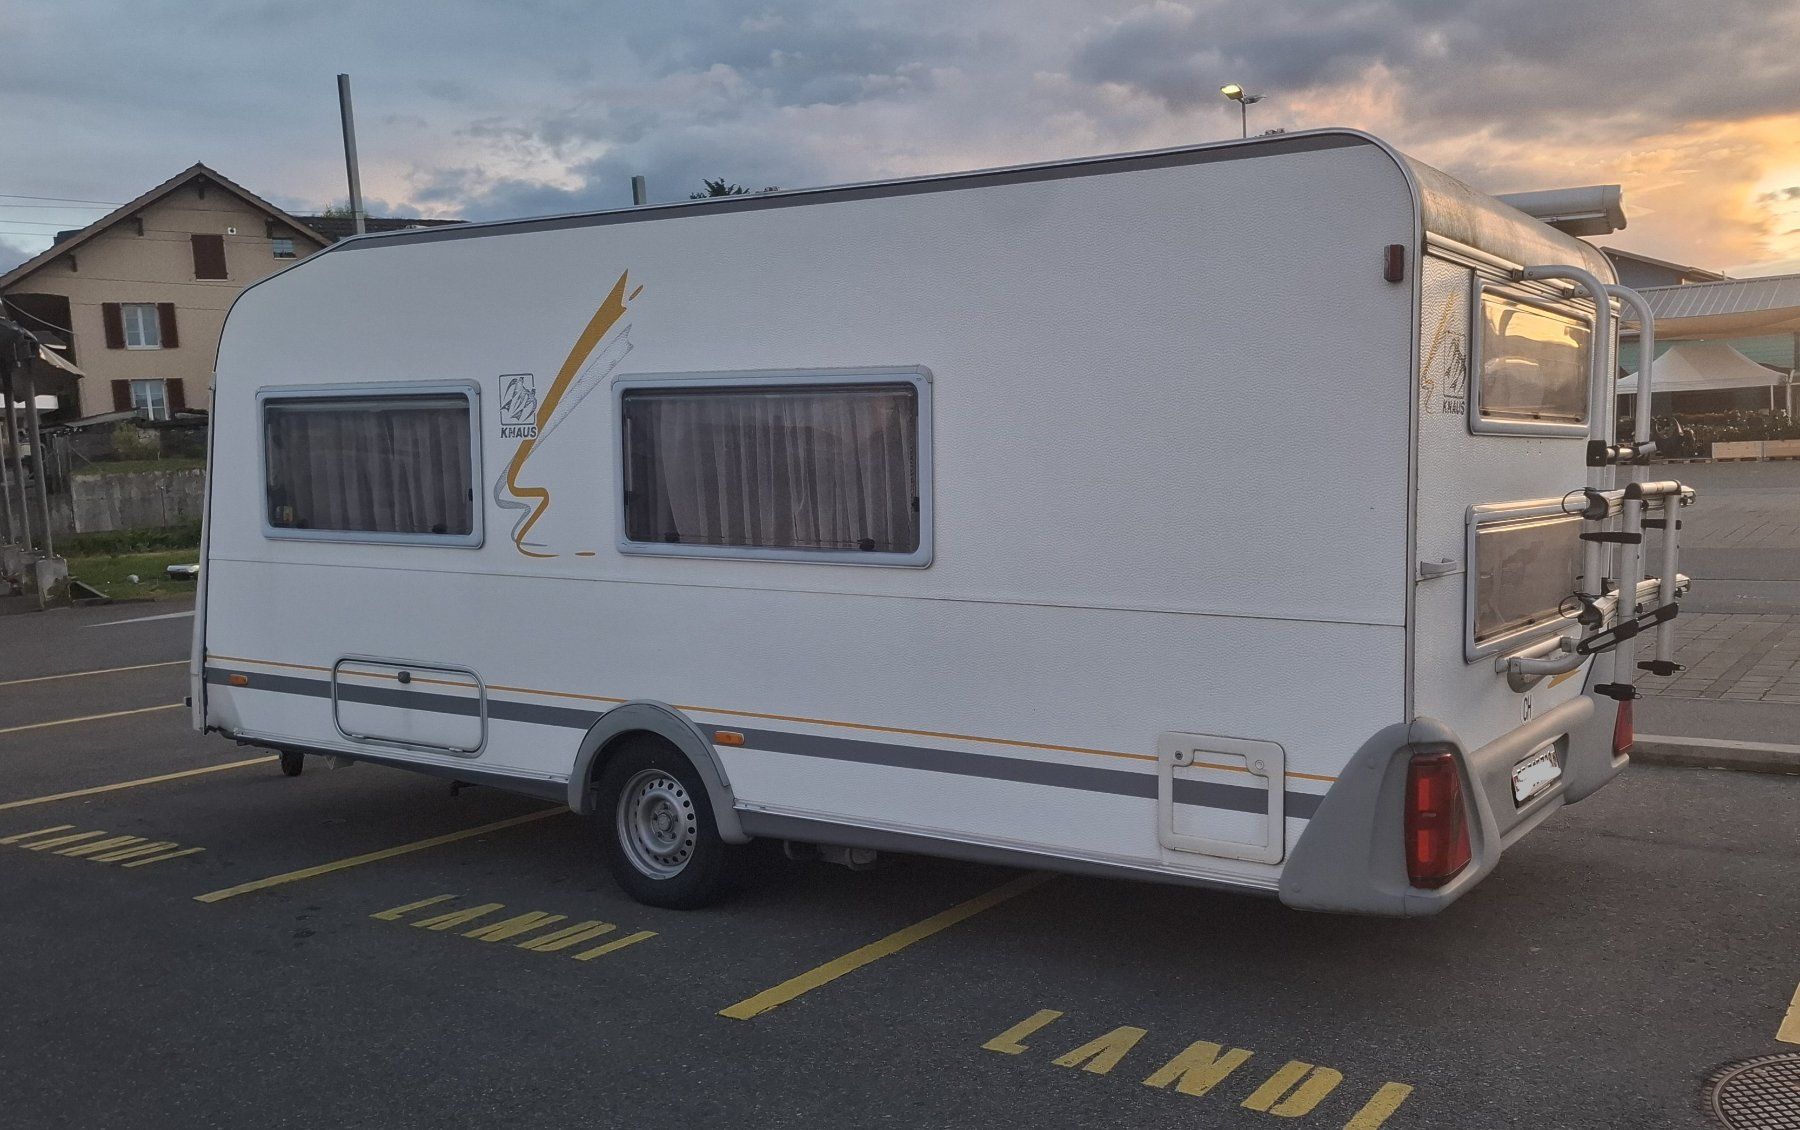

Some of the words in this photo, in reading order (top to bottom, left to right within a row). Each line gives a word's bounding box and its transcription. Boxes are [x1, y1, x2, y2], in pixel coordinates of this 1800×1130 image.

[1442, 400, 1465, 415] KNAUS
[500, 427, 537, 438] KNAUS
[1523, 694, 1532, 721] CH
[368, 894, 660, 961] LANDI
[980, 1008, 1415, 1130] LANDI
